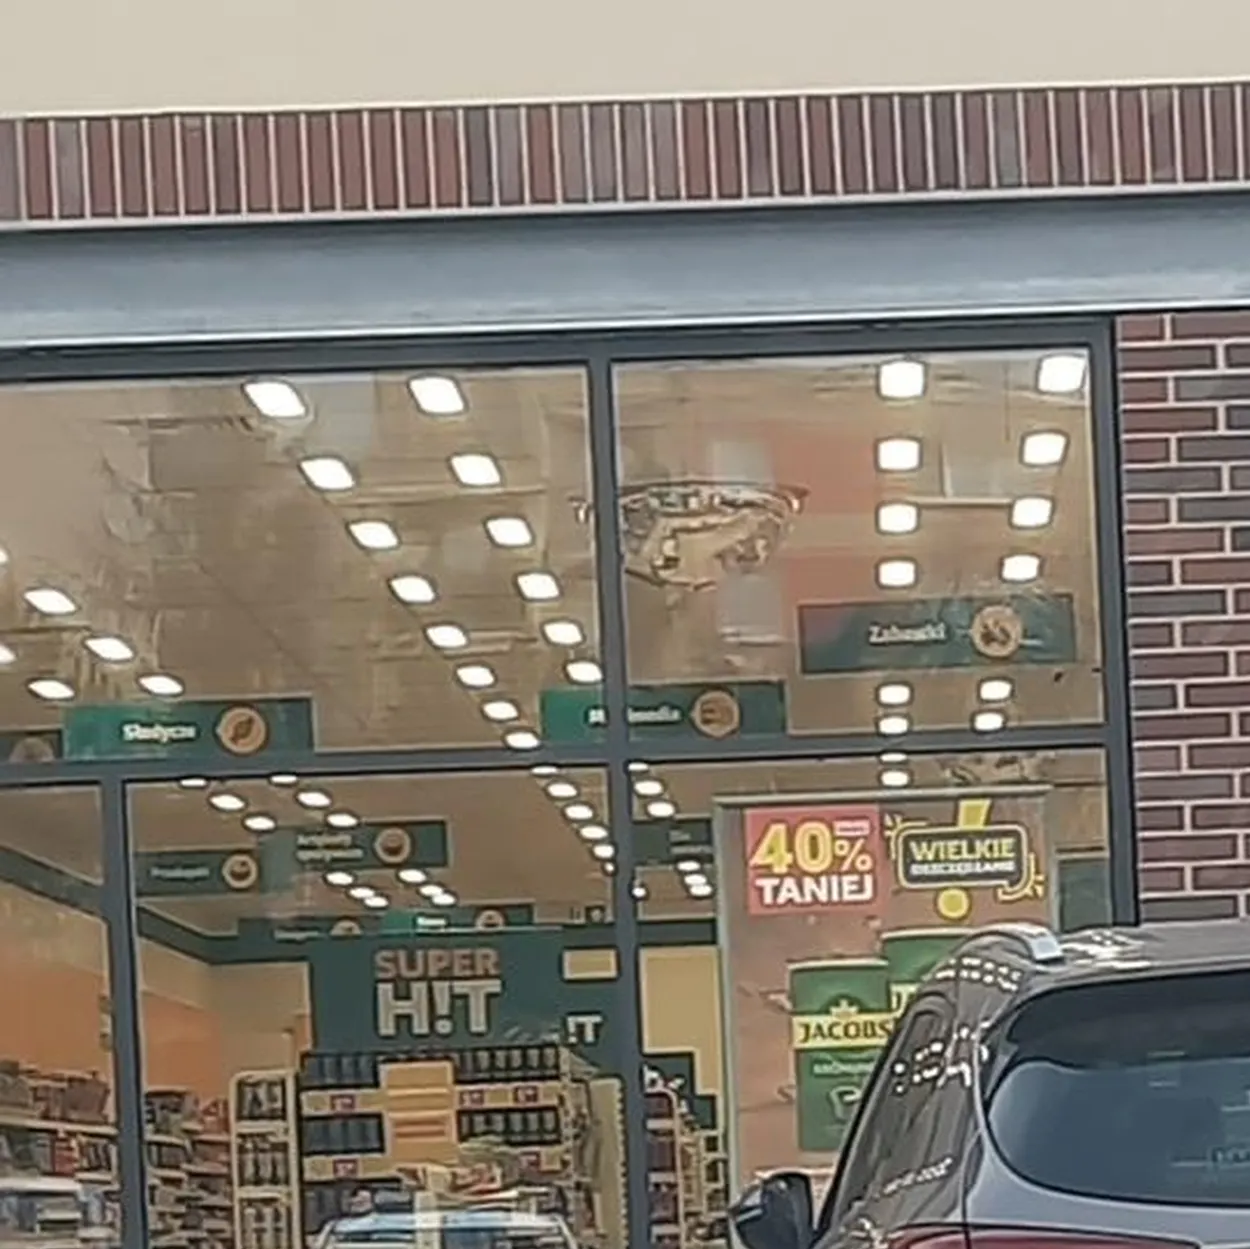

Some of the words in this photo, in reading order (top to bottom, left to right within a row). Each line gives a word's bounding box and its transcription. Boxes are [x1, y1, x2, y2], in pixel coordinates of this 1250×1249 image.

[750, 820, 874, 874] 40%
[909, 838, 1016, 860] WIELKIE
[755, 875, 873, 904] TANIEJ
[375, 948, 499, 978] SUPER
[800, 1020, 891, 1043] JACOBS
